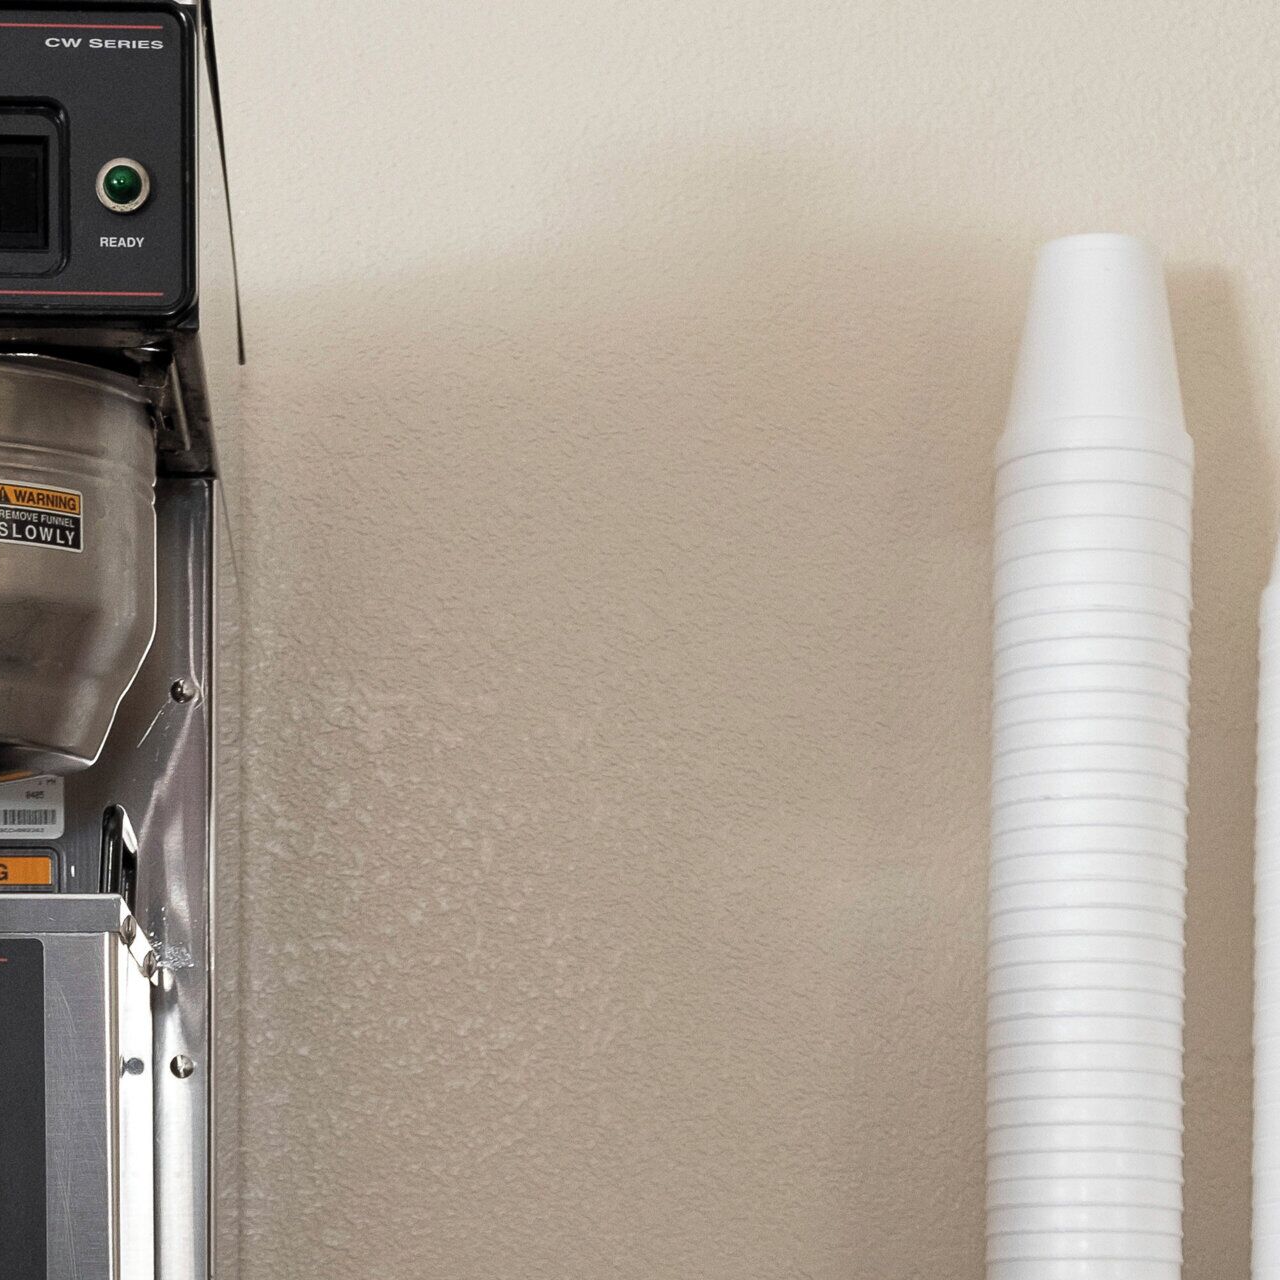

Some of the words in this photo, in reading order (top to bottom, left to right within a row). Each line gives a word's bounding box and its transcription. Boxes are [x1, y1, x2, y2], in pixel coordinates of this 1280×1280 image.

[45, 38, 81, 48] CW
[88, 39, 164, 50] SERIES
[99, 236, 145, 249] READY
[13, 489, 78, 511] WARNING
[40, 514, 76, 529] FUNNEL
